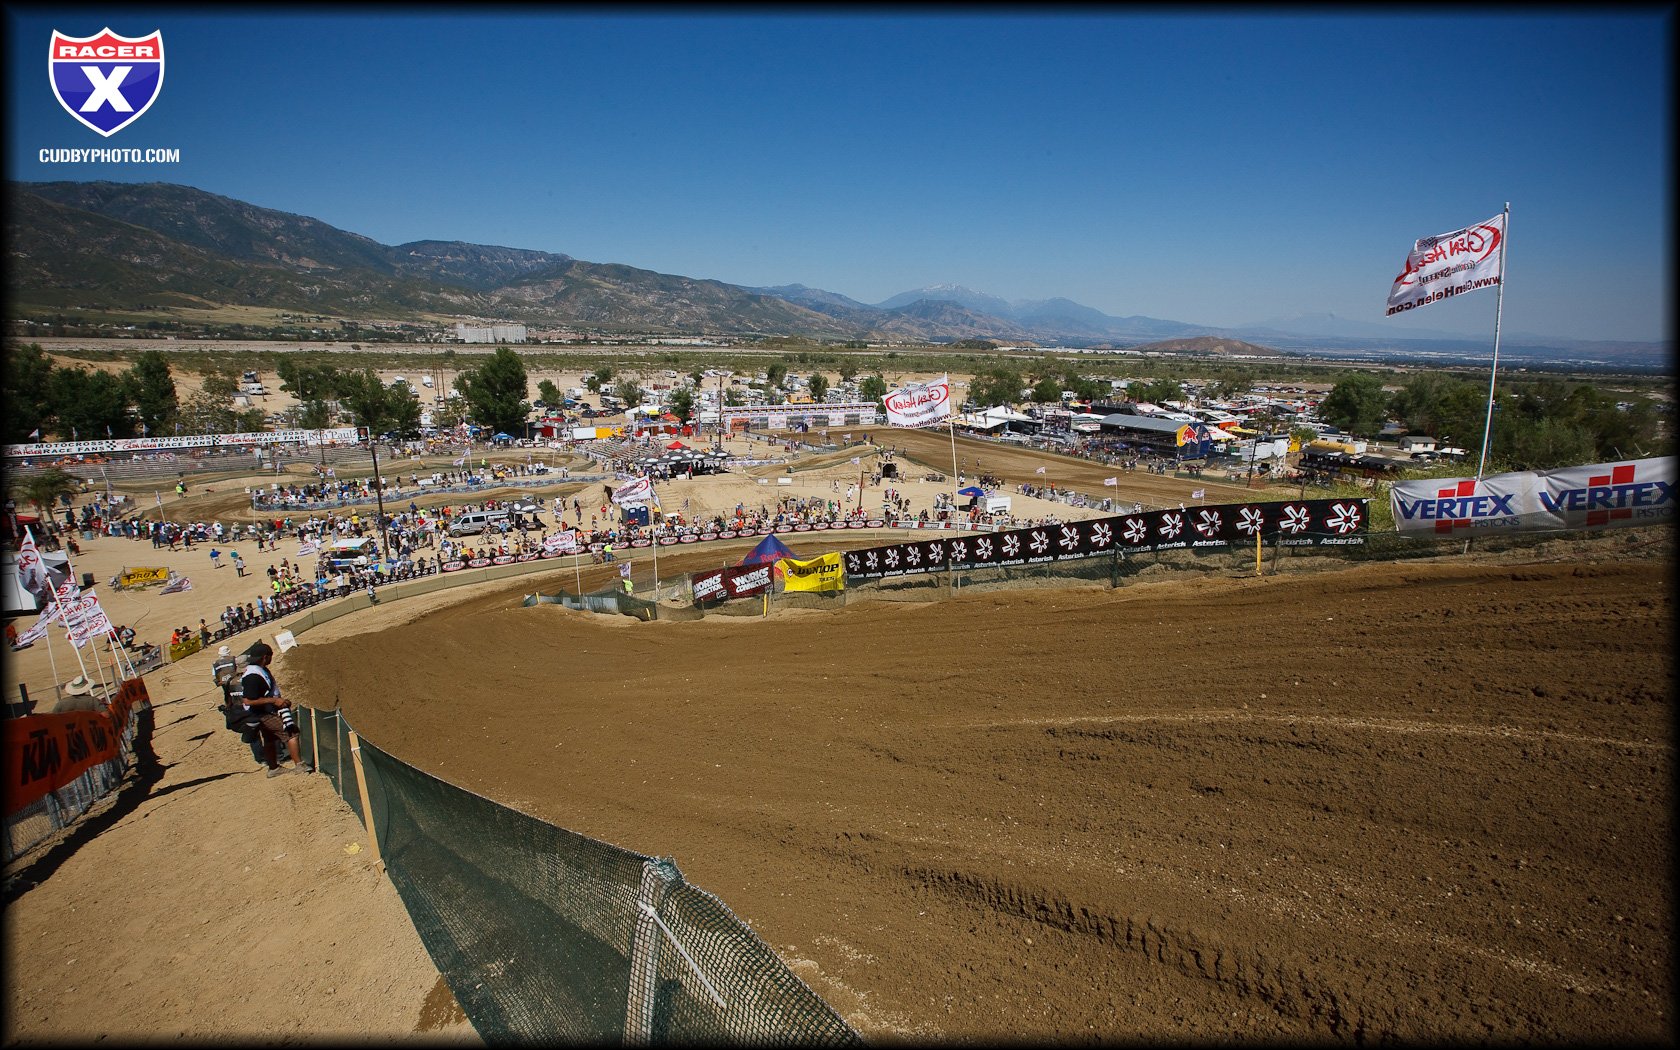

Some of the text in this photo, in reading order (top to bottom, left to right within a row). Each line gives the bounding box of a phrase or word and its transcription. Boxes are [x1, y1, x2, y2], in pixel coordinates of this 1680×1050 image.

[34, 440, 104, 449] MOTOCROSS
[1539, 480, 1679, 512] VERTEX
[1398, 494, 1514, 520] VERTEX
[1474, 516, 1520, 528] PISTONS
[1156, 540, 1186, 550] Asterisk
[1320, 537, 1364, 545] Asterisk
[1058, 552, 1084, 560] Asterisk
[1000, 558, 1024, 566] Asterisk
[797, 564, 839, 574] DUNLOP
[732, 566, 769, 586] WORKS
[21, 728, 61, 786] KTM
